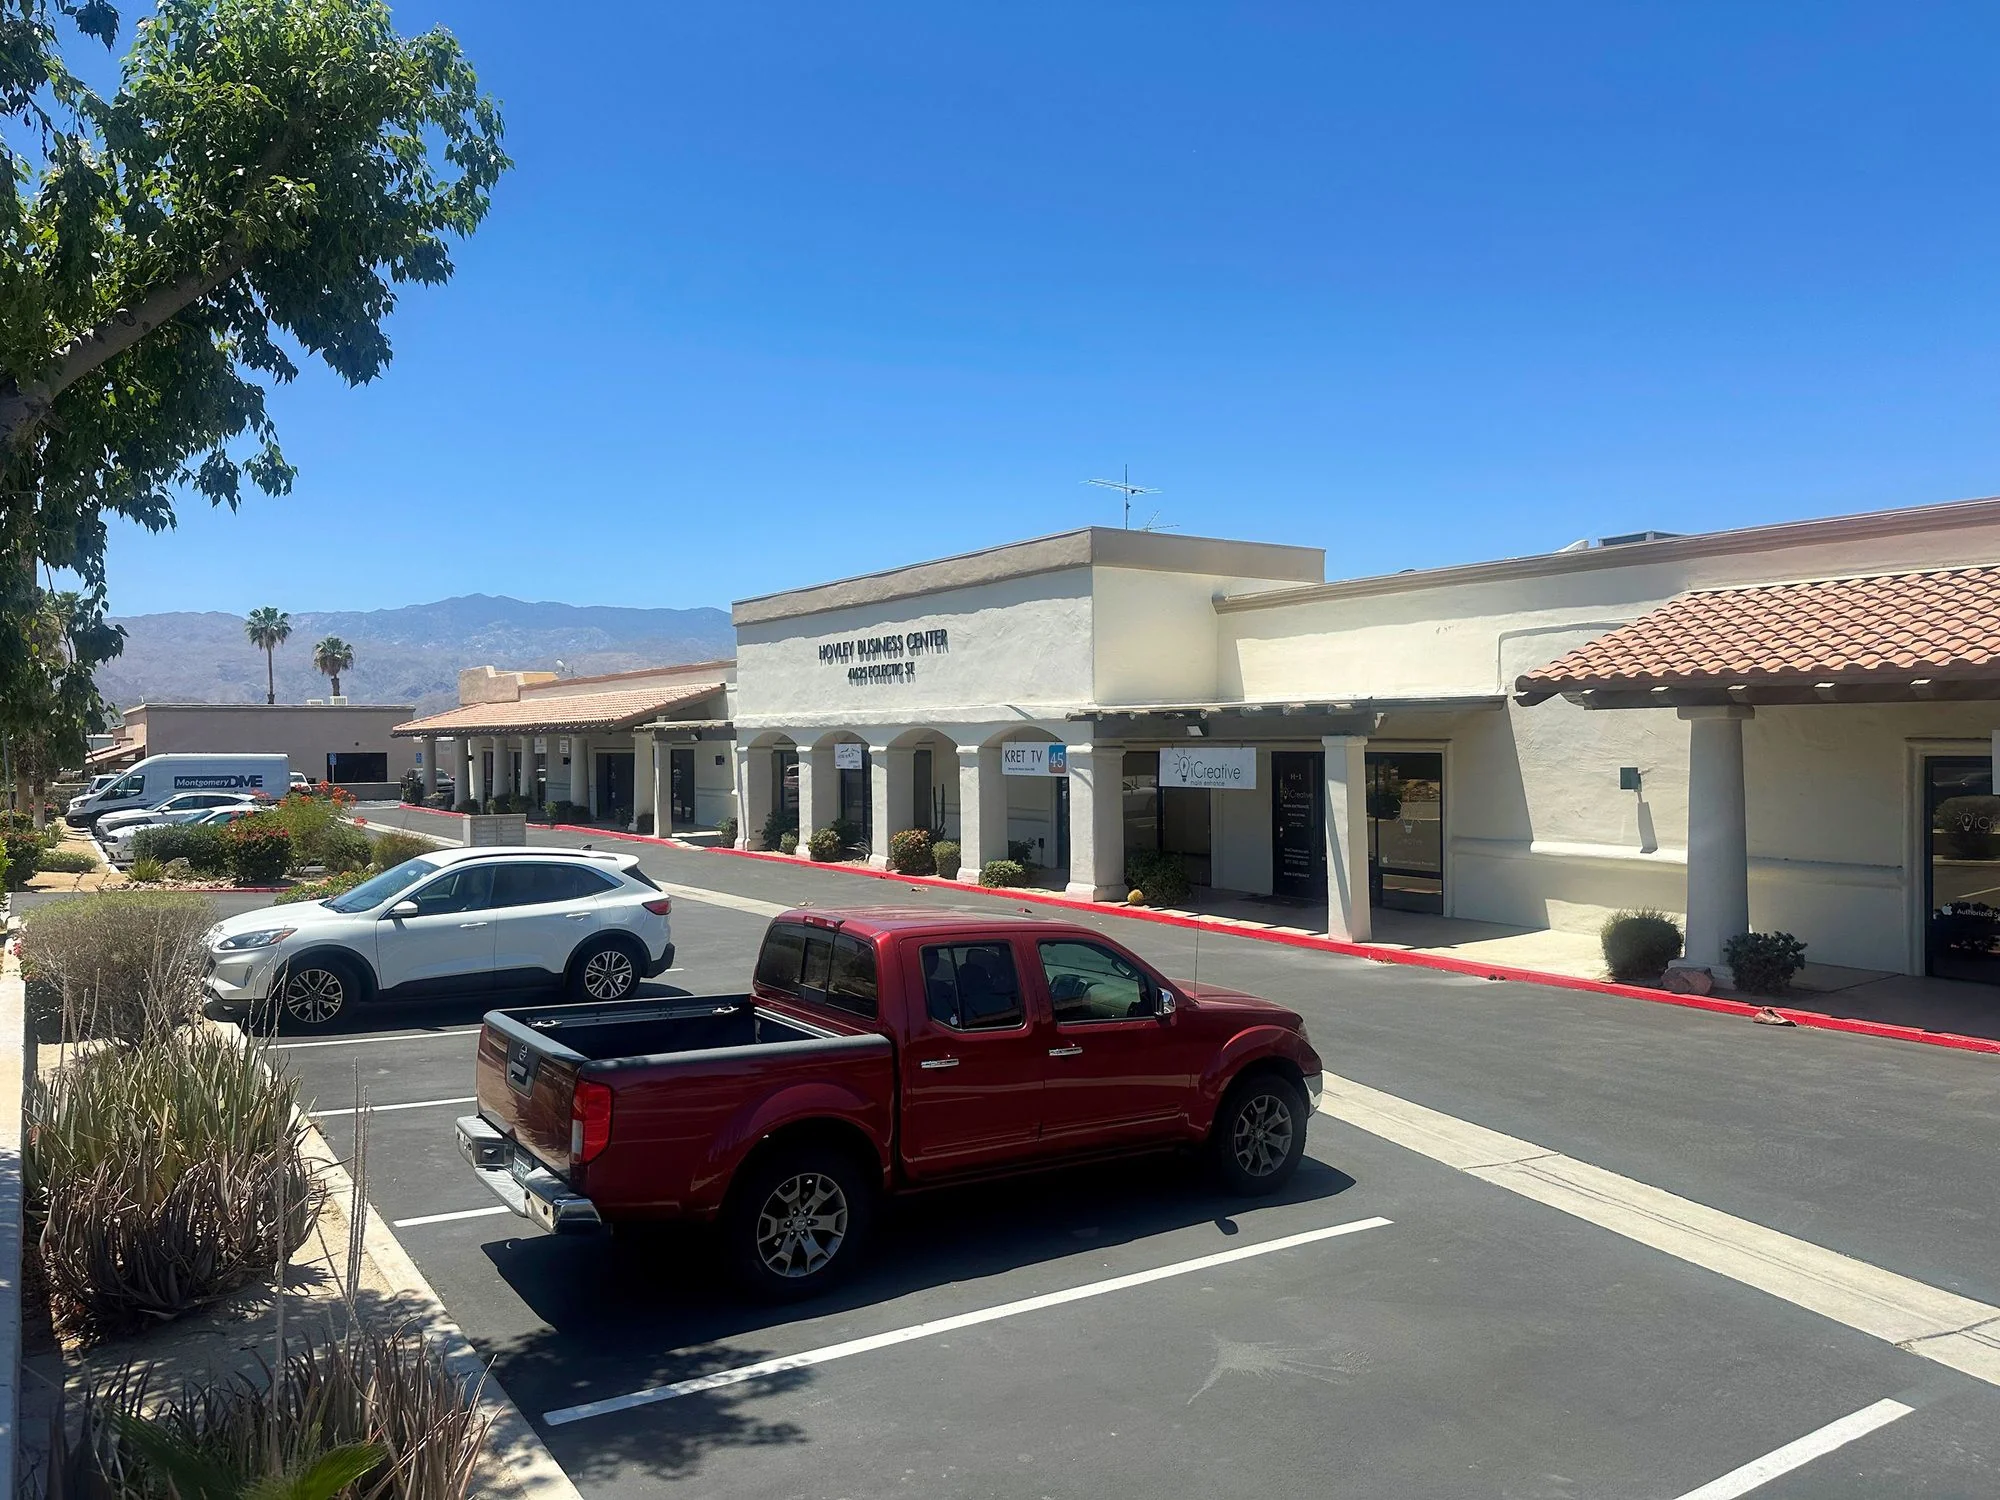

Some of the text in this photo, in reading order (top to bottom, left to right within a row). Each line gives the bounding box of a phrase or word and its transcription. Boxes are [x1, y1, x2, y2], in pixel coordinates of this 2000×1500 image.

[819, 629, 948, 660] HOVLEY BUSINESS CENTER
[868, 663, 903, 677] ECLECTIC
[1004, 749, 1043, 763] KRET TV
[1050, 752, 1064, 768] 45
[1190, 760, 1241, 779] iCreative
[176, 778, 229, 787] Montgomery
[1957, 908, 1993, 917] Authorized
